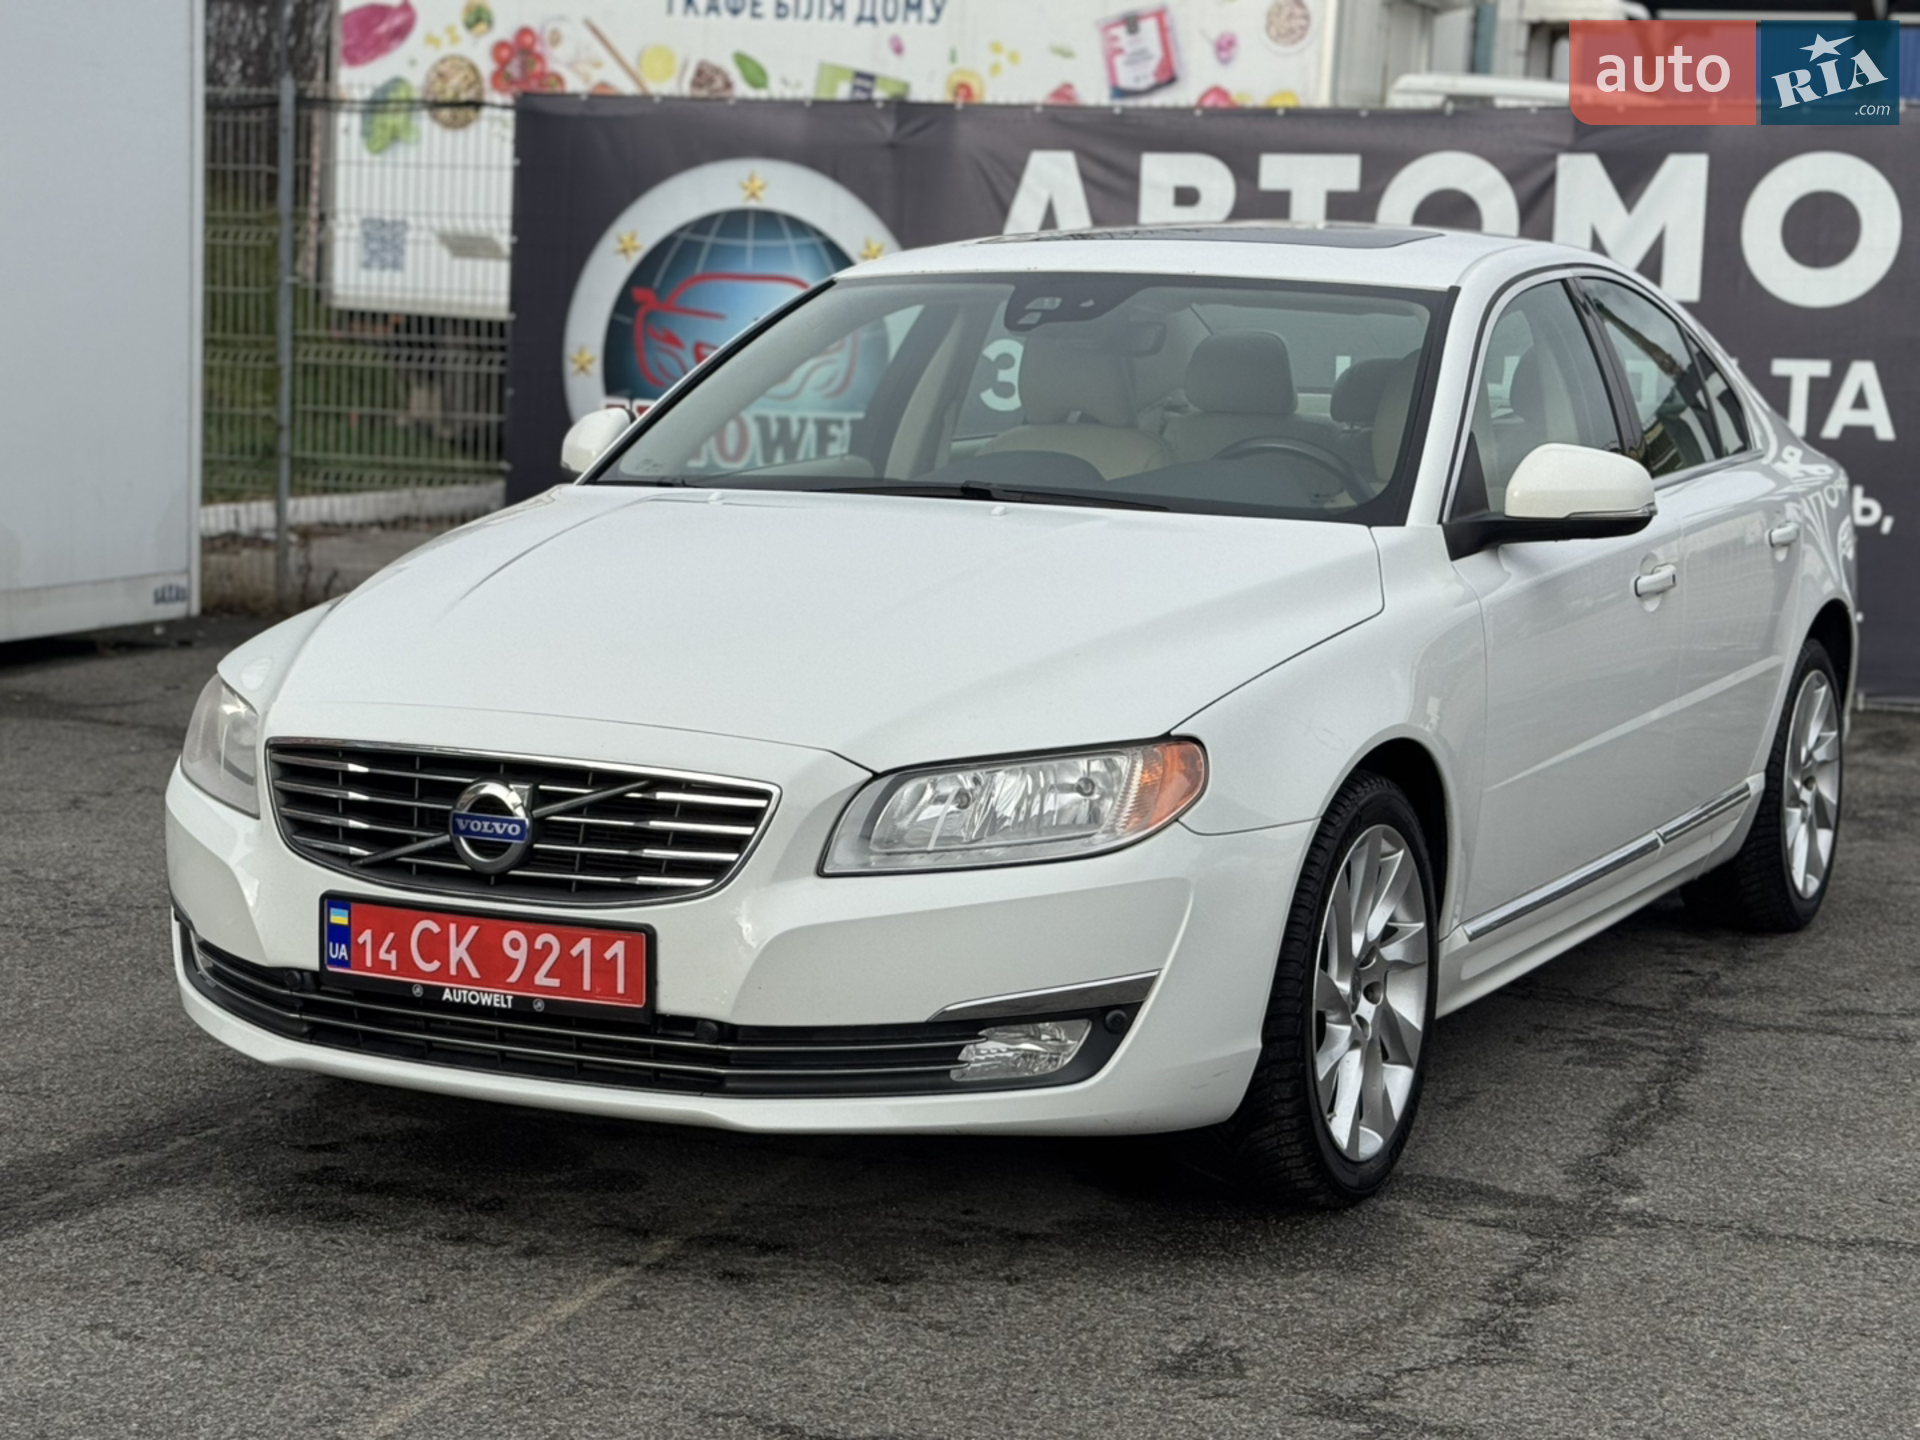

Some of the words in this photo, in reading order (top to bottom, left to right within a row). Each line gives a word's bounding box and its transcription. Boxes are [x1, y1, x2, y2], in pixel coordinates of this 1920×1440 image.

[855, 0, 948, 26] ДОМУ
[455, 818, 521, 836] VOLVO
[328, 942, 348, 960] UA
[502, 930, 626, 994] 9211
[442, 987, 513, 1009] AUTOWELT
